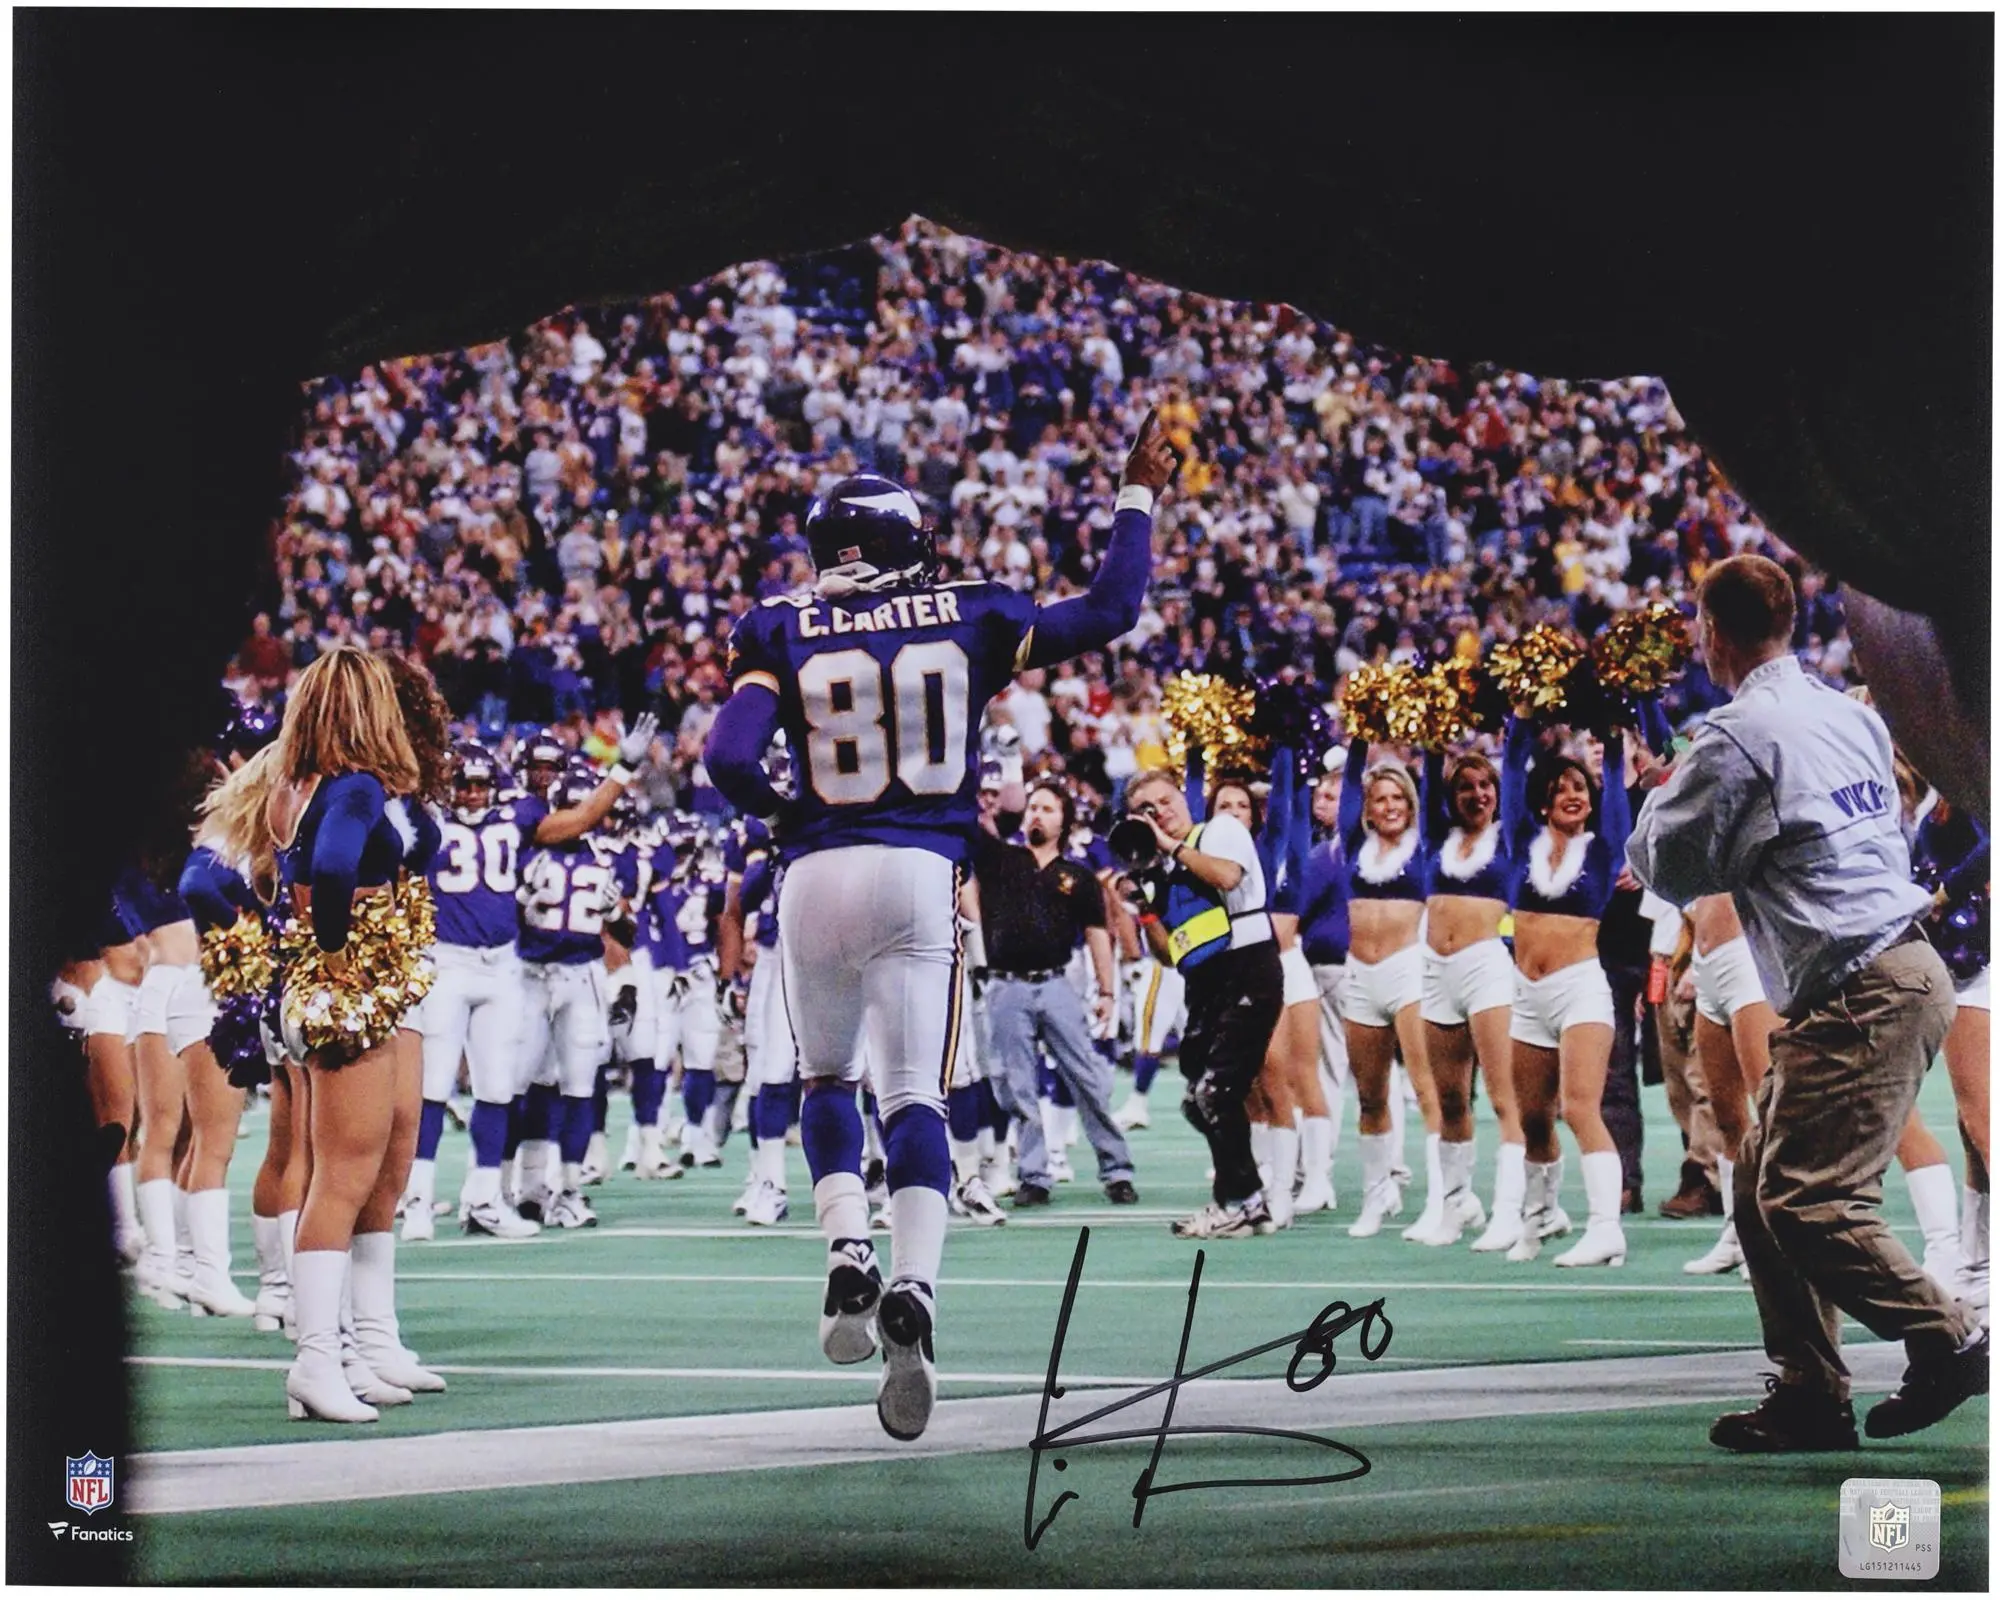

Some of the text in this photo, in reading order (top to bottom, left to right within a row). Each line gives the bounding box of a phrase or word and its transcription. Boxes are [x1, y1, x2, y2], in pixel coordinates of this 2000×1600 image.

[798, 639, 969, 805] 80
[435, 821, 521, 893] 30
[524, 859, 608, 935] 22
[1873, 1523, 1907, 1547] NFL
[1915, 1543, 1932, 1552] PSS
[1859, 1561, 1922, 1571] LG151211445
